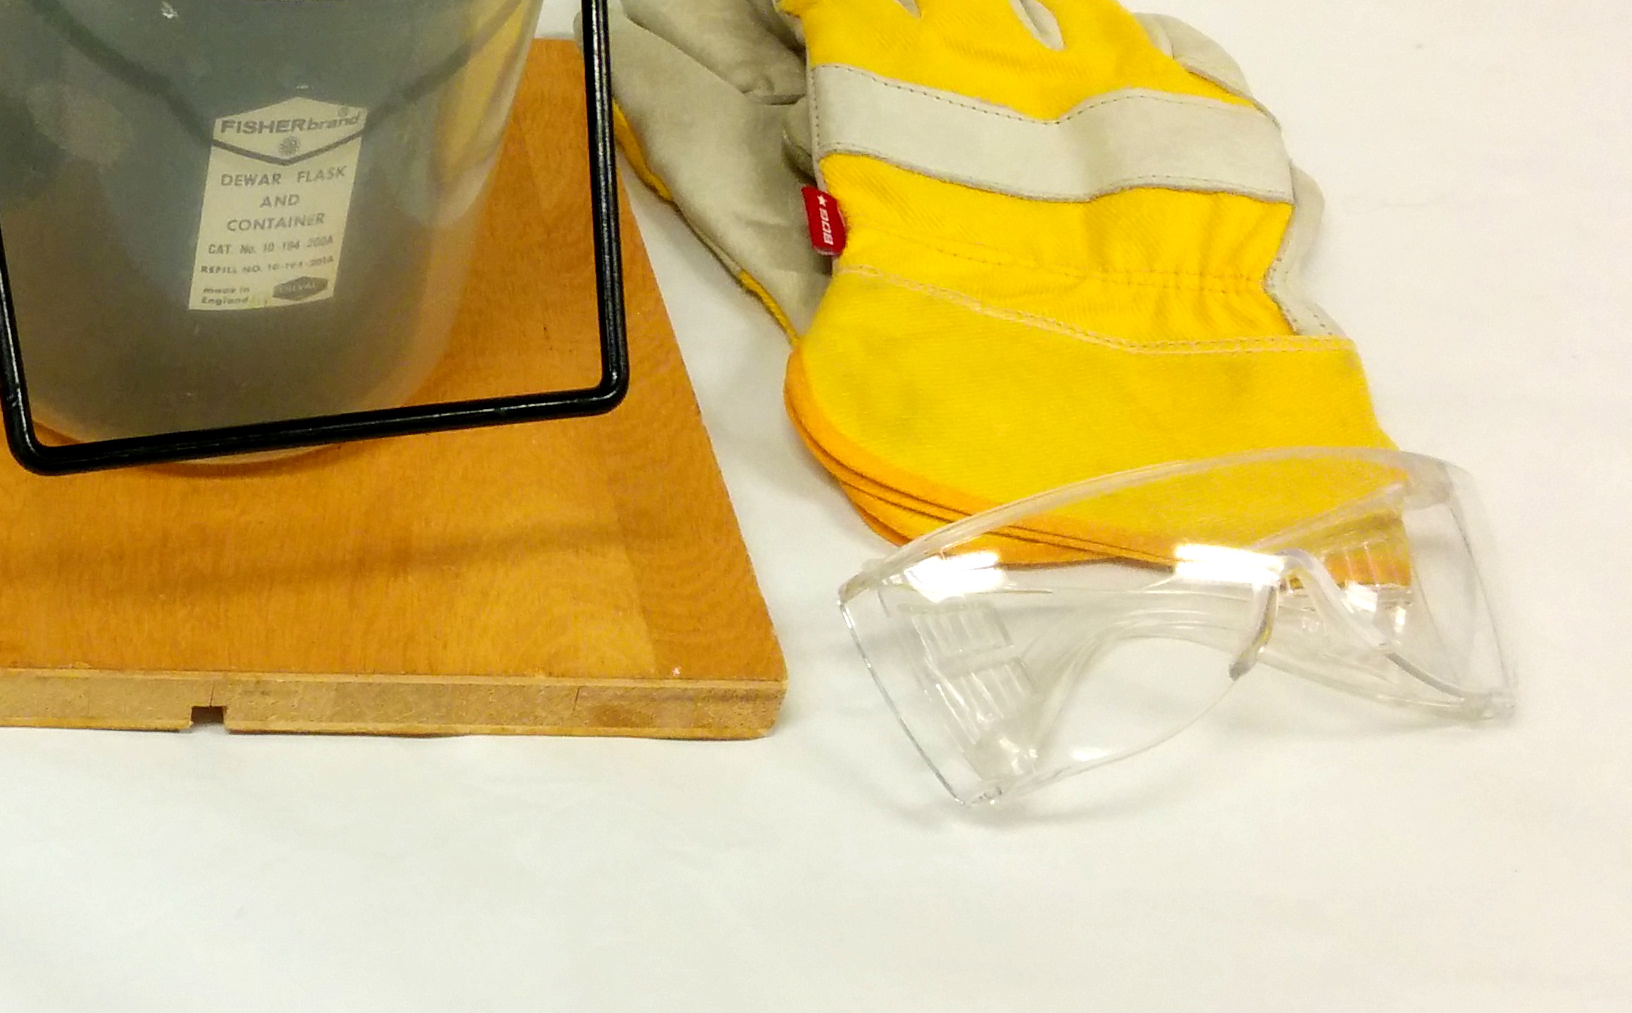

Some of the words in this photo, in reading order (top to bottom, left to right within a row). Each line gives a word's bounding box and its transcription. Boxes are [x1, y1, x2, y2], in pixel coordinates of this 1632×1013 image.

[220, 114, 360, 134] FISHERbrand
[221, 173, 282, 186] DEWAR
[297, 165, 347, 183] FLASK
[260, 194, 300, 208] AND
[227, 213, 325, 231] CONTAINER
